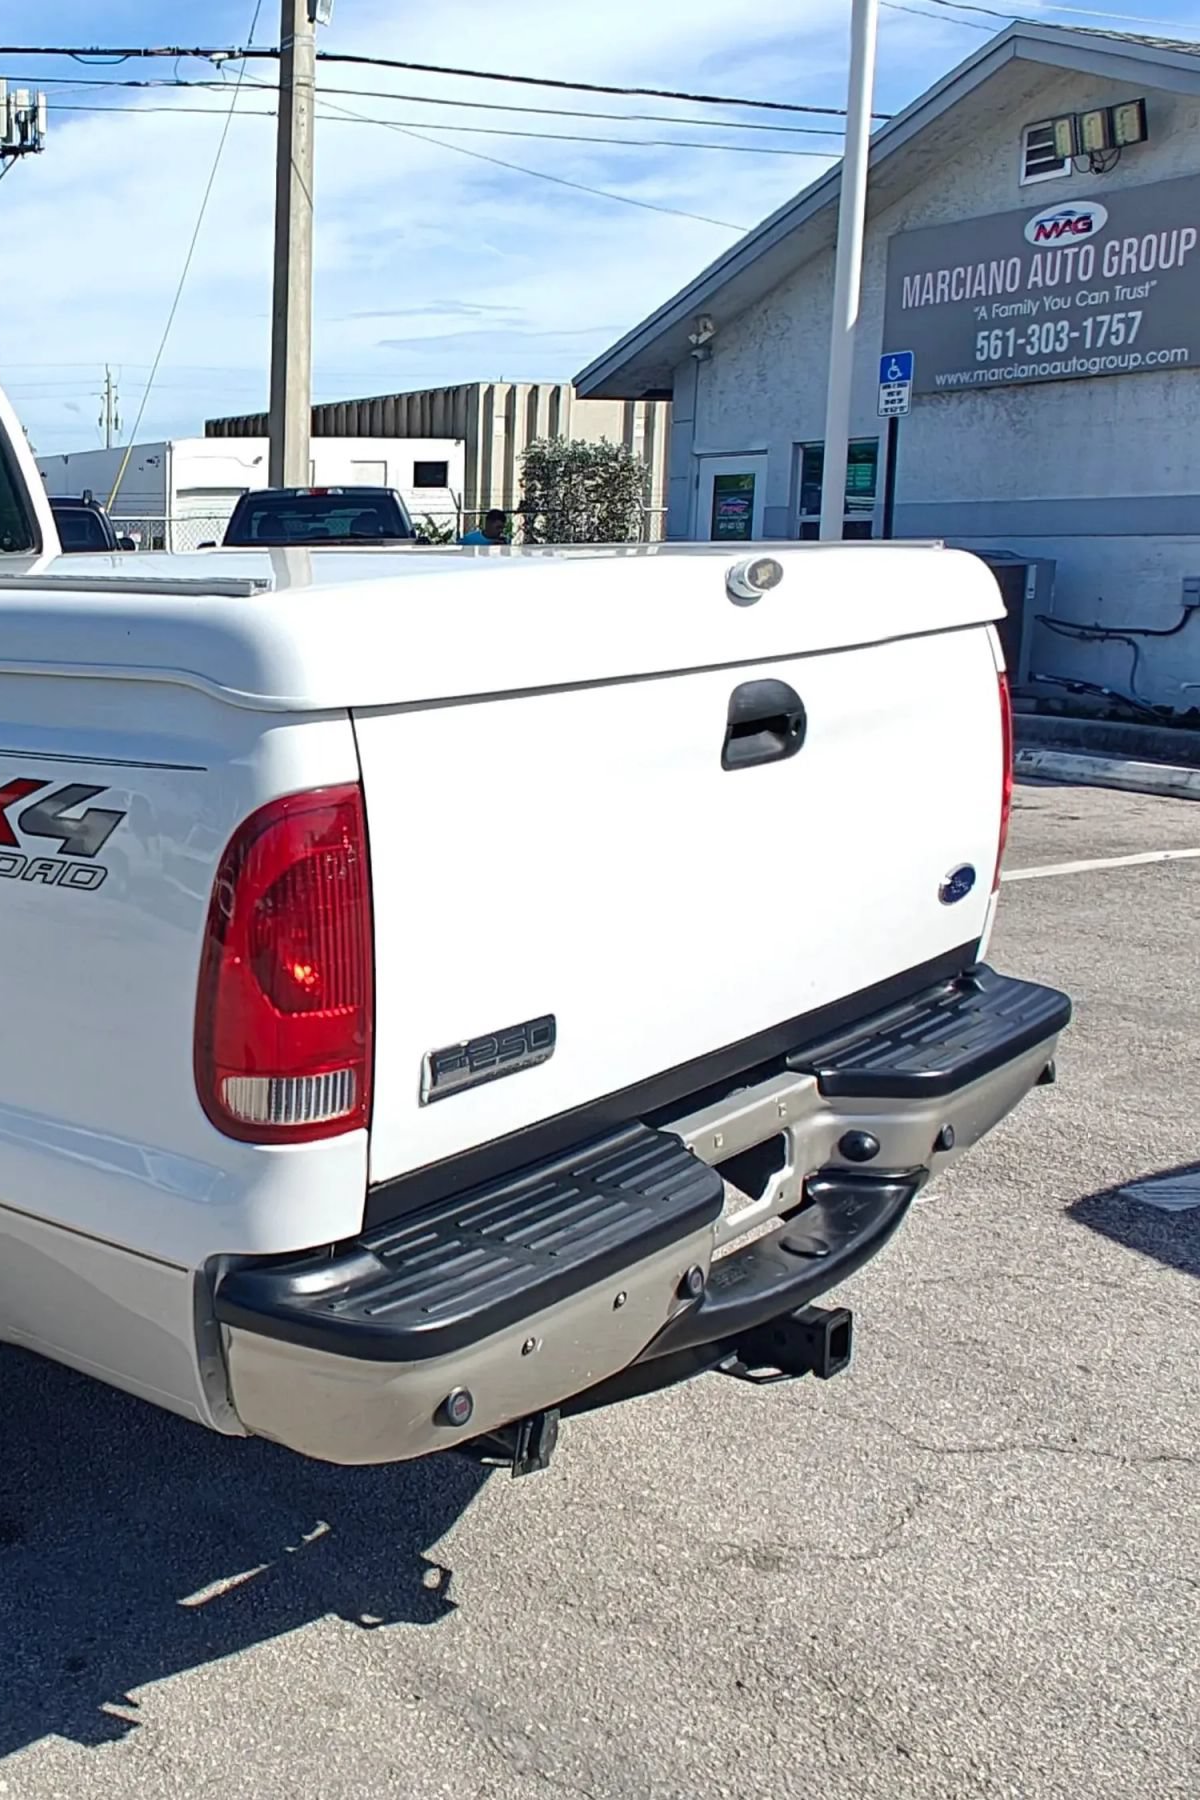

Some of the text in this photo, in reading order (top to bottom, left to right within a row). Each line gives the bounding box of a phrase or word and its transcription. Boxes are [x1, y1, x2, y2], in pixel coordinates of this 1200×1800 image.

[1033, 214, 1094, 242] MAG
[901, 227, 1197, 310] MARCIANO AUTO GROUP
[991, 299, 1041, 318] Family
[1042, 295, 1072, 312] You
[1075, 290, 1110, 307] Can
[974, 310, 1143, 362] 561-303-1757
[935, 347, 1189, 386] www.marcianoautogroup.com
